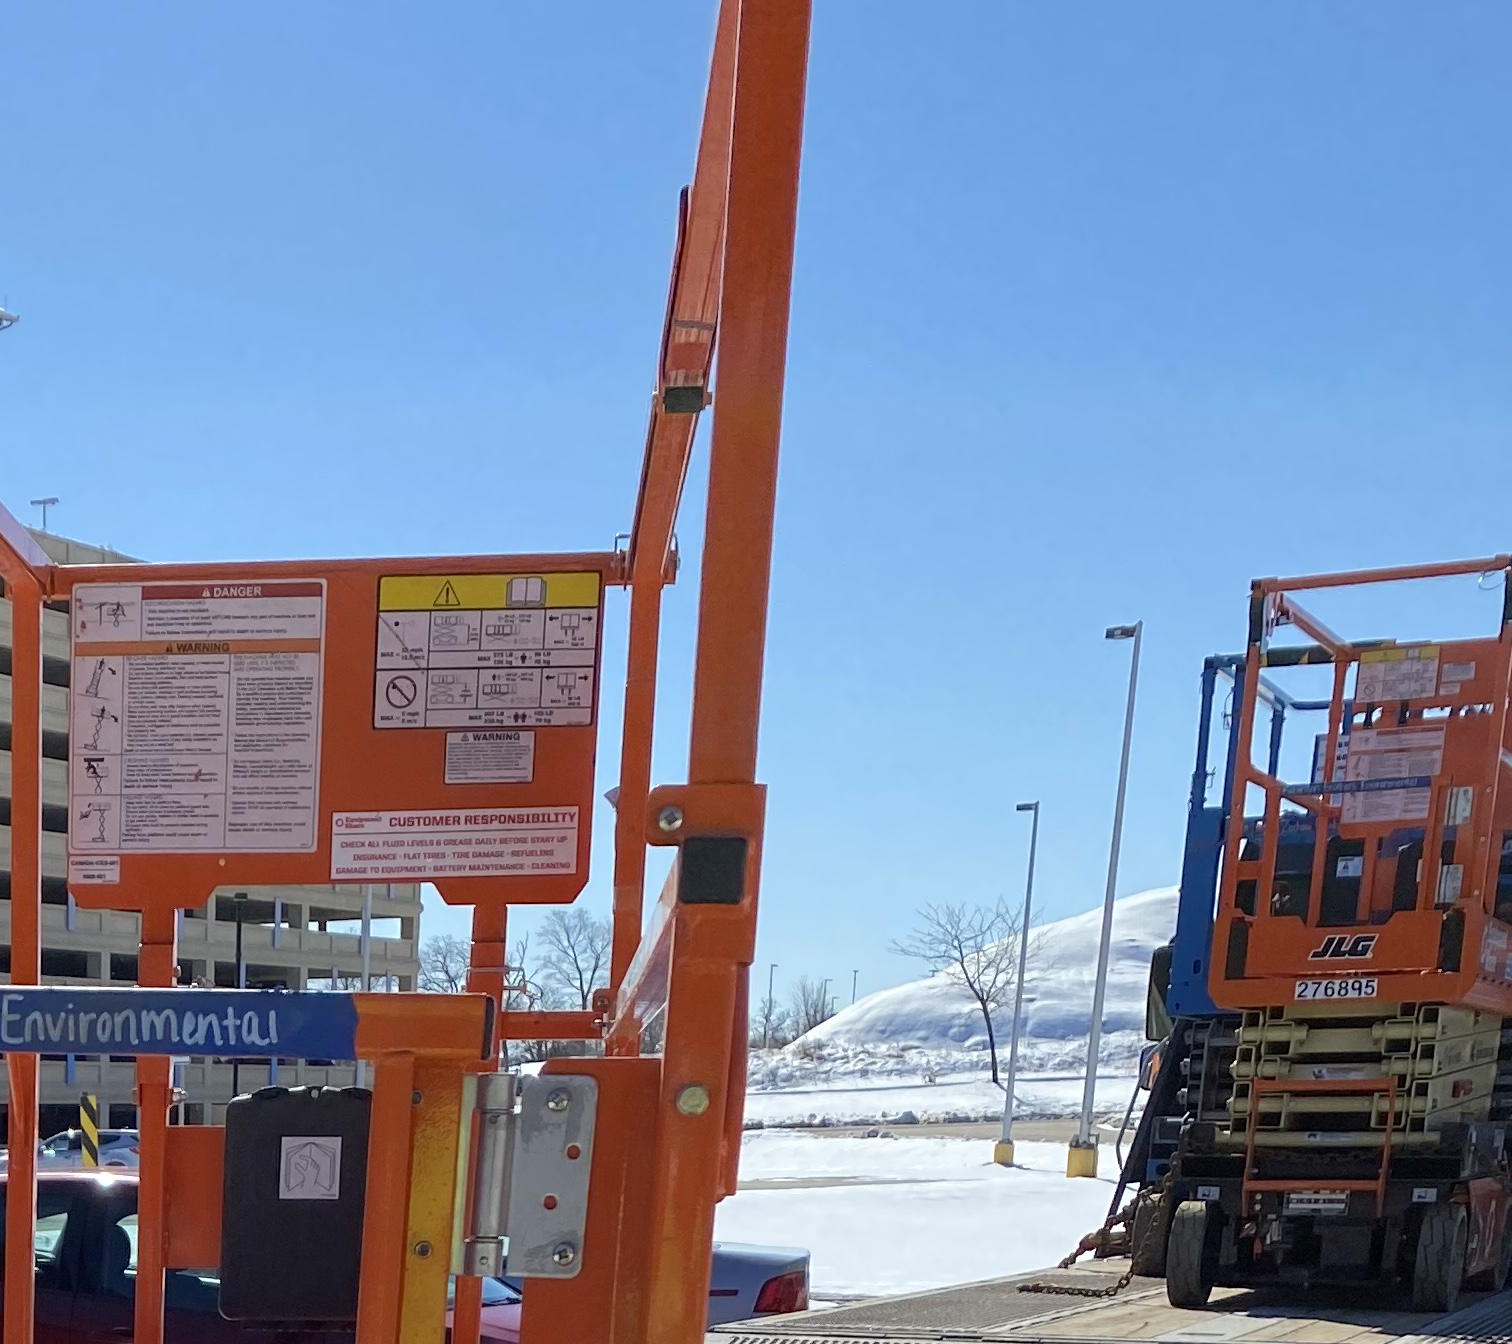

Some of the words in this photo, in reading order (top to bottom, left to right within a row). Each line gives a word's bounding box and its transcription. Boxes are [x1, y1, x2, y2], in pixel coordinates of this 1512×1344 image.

[213, 586, 262, 598] DANGER
[176, 642, 230, 653] WARNING
[472, 732, 521, 742] WARNING
[389, 815, 461, 828] CUSTOMER
[464, 812, 576, 826] RESPONSIBILITY
[340, 840, 366, 849] CHECK
[367, 840, 379, 848] ALL
[382, 839, 406, 848] FLUID
[407, 838, 435, 847] LEVELS
[443, 837, 473, 847] GREASE
[474, 837, 498, 846] DAILY
[499, 836, 528, 845] BEFORE
[530, 835, 555, 844] START
[556, 835, 568, 843] UP
[352, 853, 397, 861] INSURANCE
[403, 852, 421, 860] FLAT
[423, 851, 446, 860] TIRES
[452, 851, 470, 859] TIRE
[471, 850, 505, 859] DAMAGE
[510, 849, 554, 858] REFUELING
[335, 866, 368, 875] DAMAGE
[370, 866, 380, 874] TO
[381, 865, 427, 874] EQUIPMENT
[433, 864, 467, 873] BATTERY
[468, 863, 526, 872] MAINTENANCE
[531, 862, 571, 870] CLEANING
[1308, 933, 1380, 961] JLG
[1297, 979, 1375, 998] 276895
[1, 993, 279, 1047] Environmental
